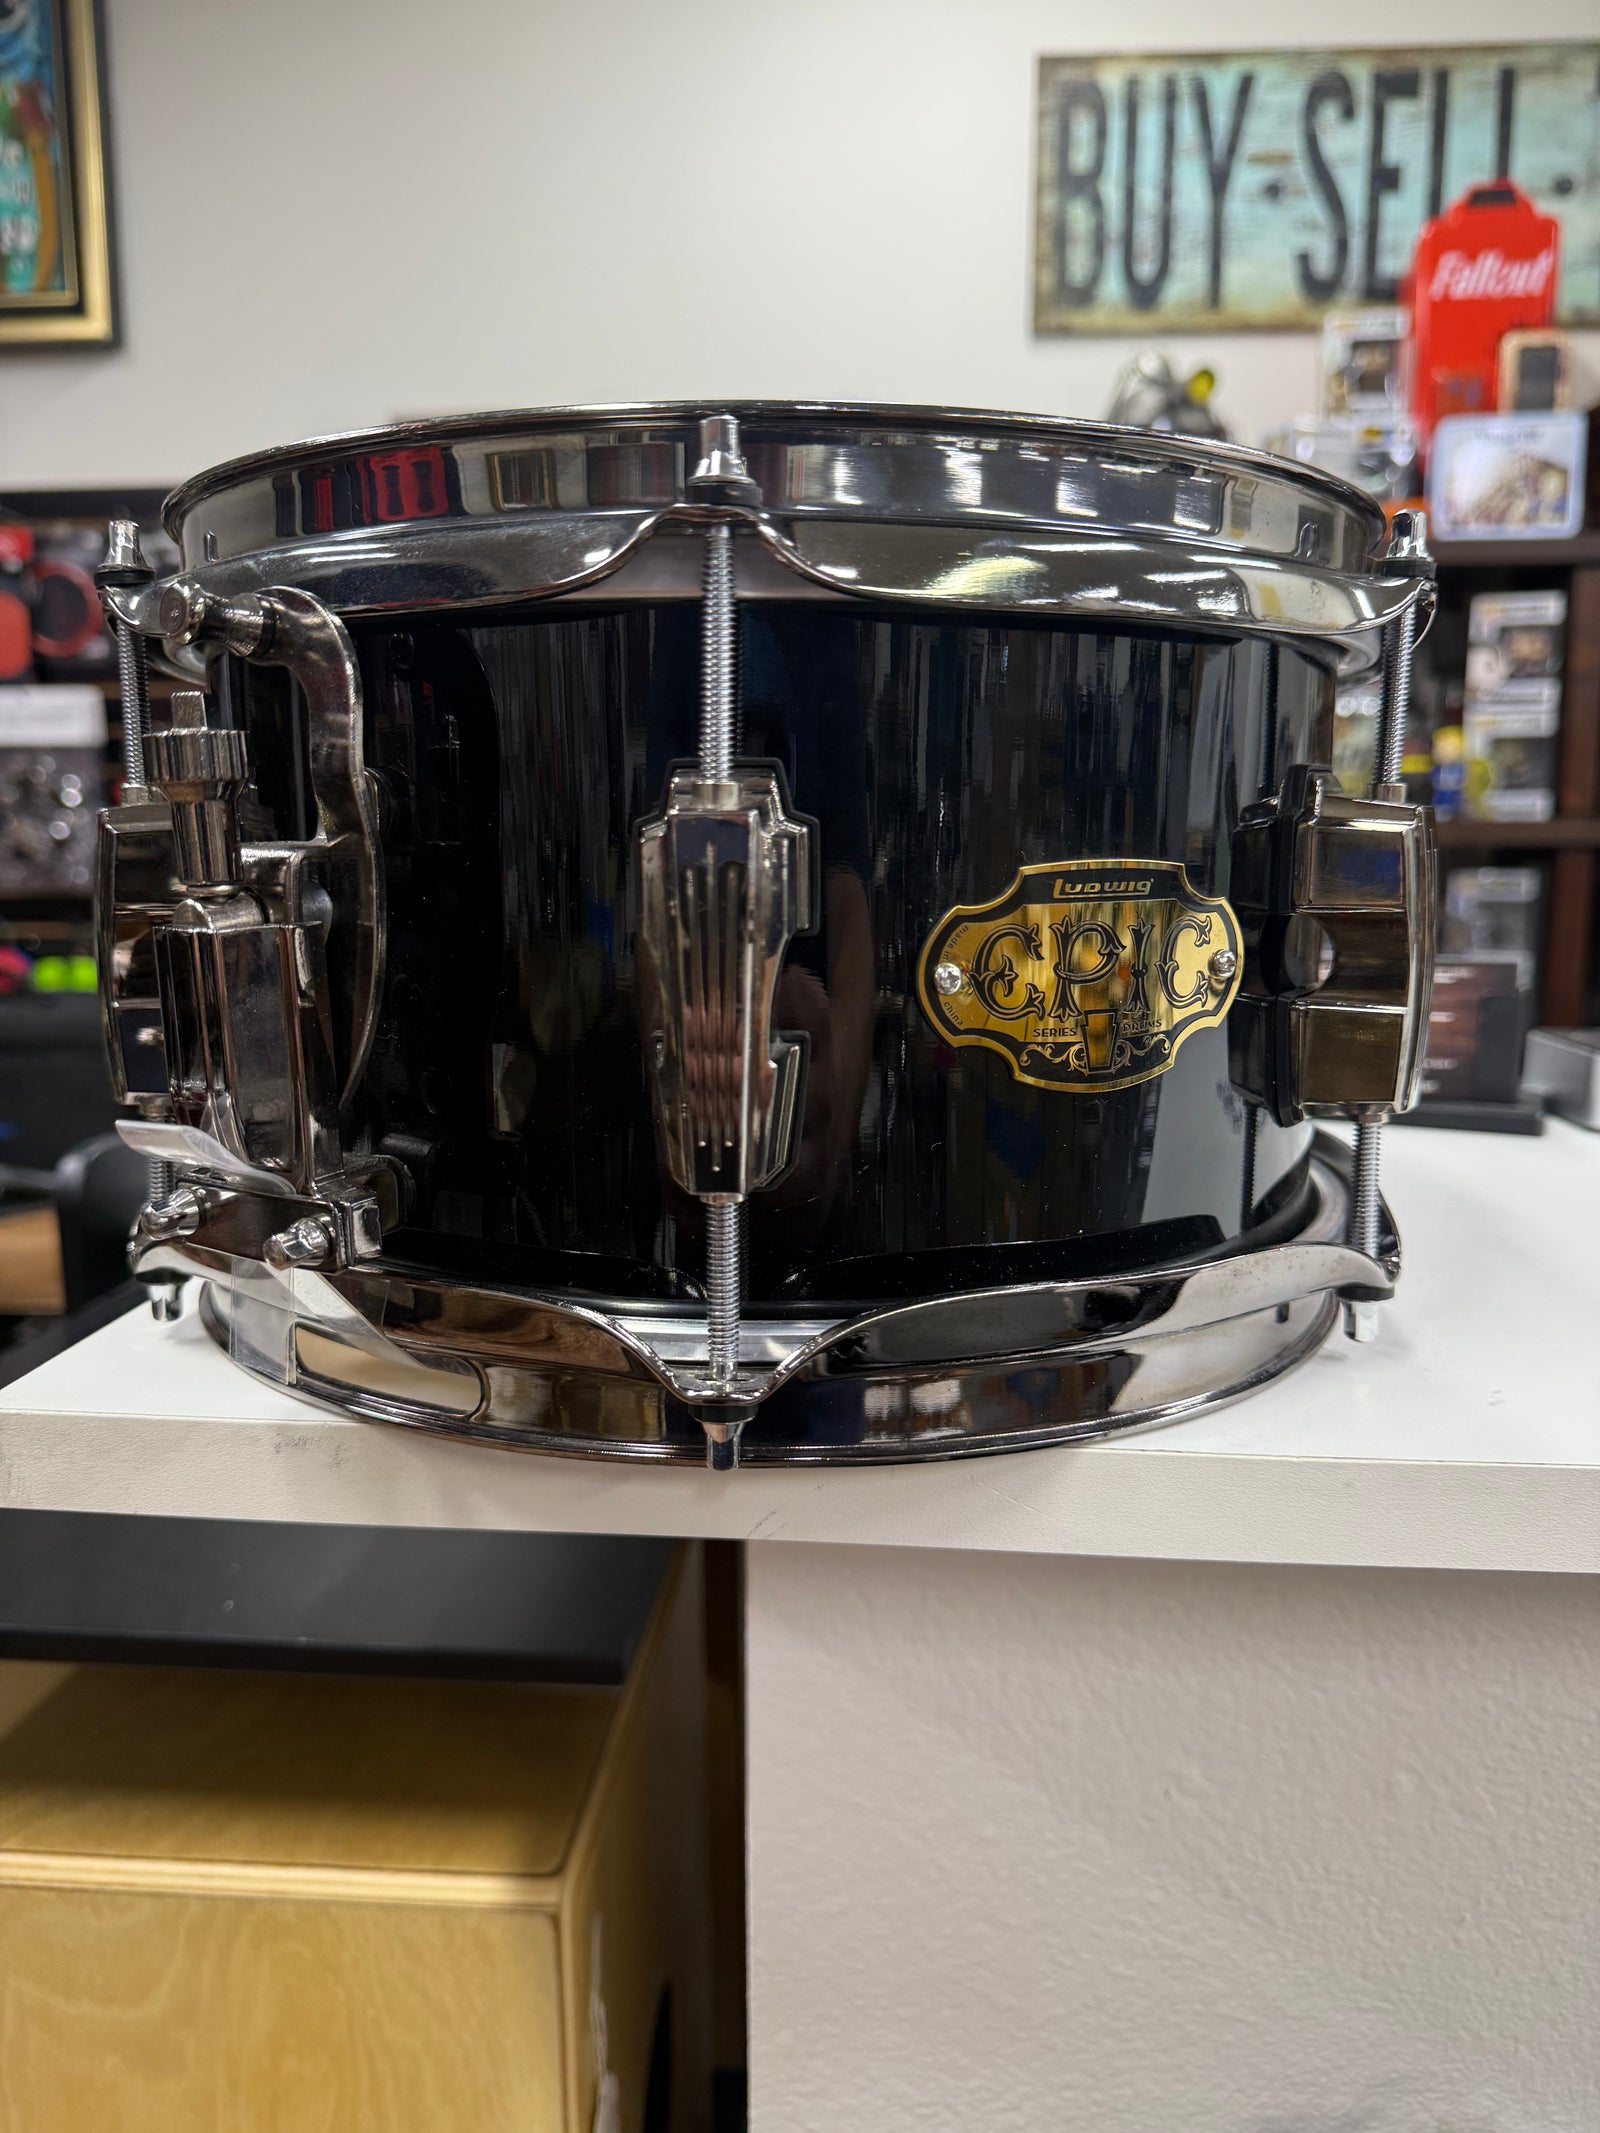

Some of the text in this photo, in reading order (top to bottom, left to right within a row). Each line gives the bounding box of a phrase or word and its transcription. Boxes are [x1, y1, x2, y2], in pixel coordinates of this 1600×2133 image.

[1055, 71, 1254, 307] BUY
[1428, 248, 1554, 301] Fallout
[967, 914, 1212, 1023] EPIC
[1033, 1018, 1162, 1038] SERIES DRUMS
